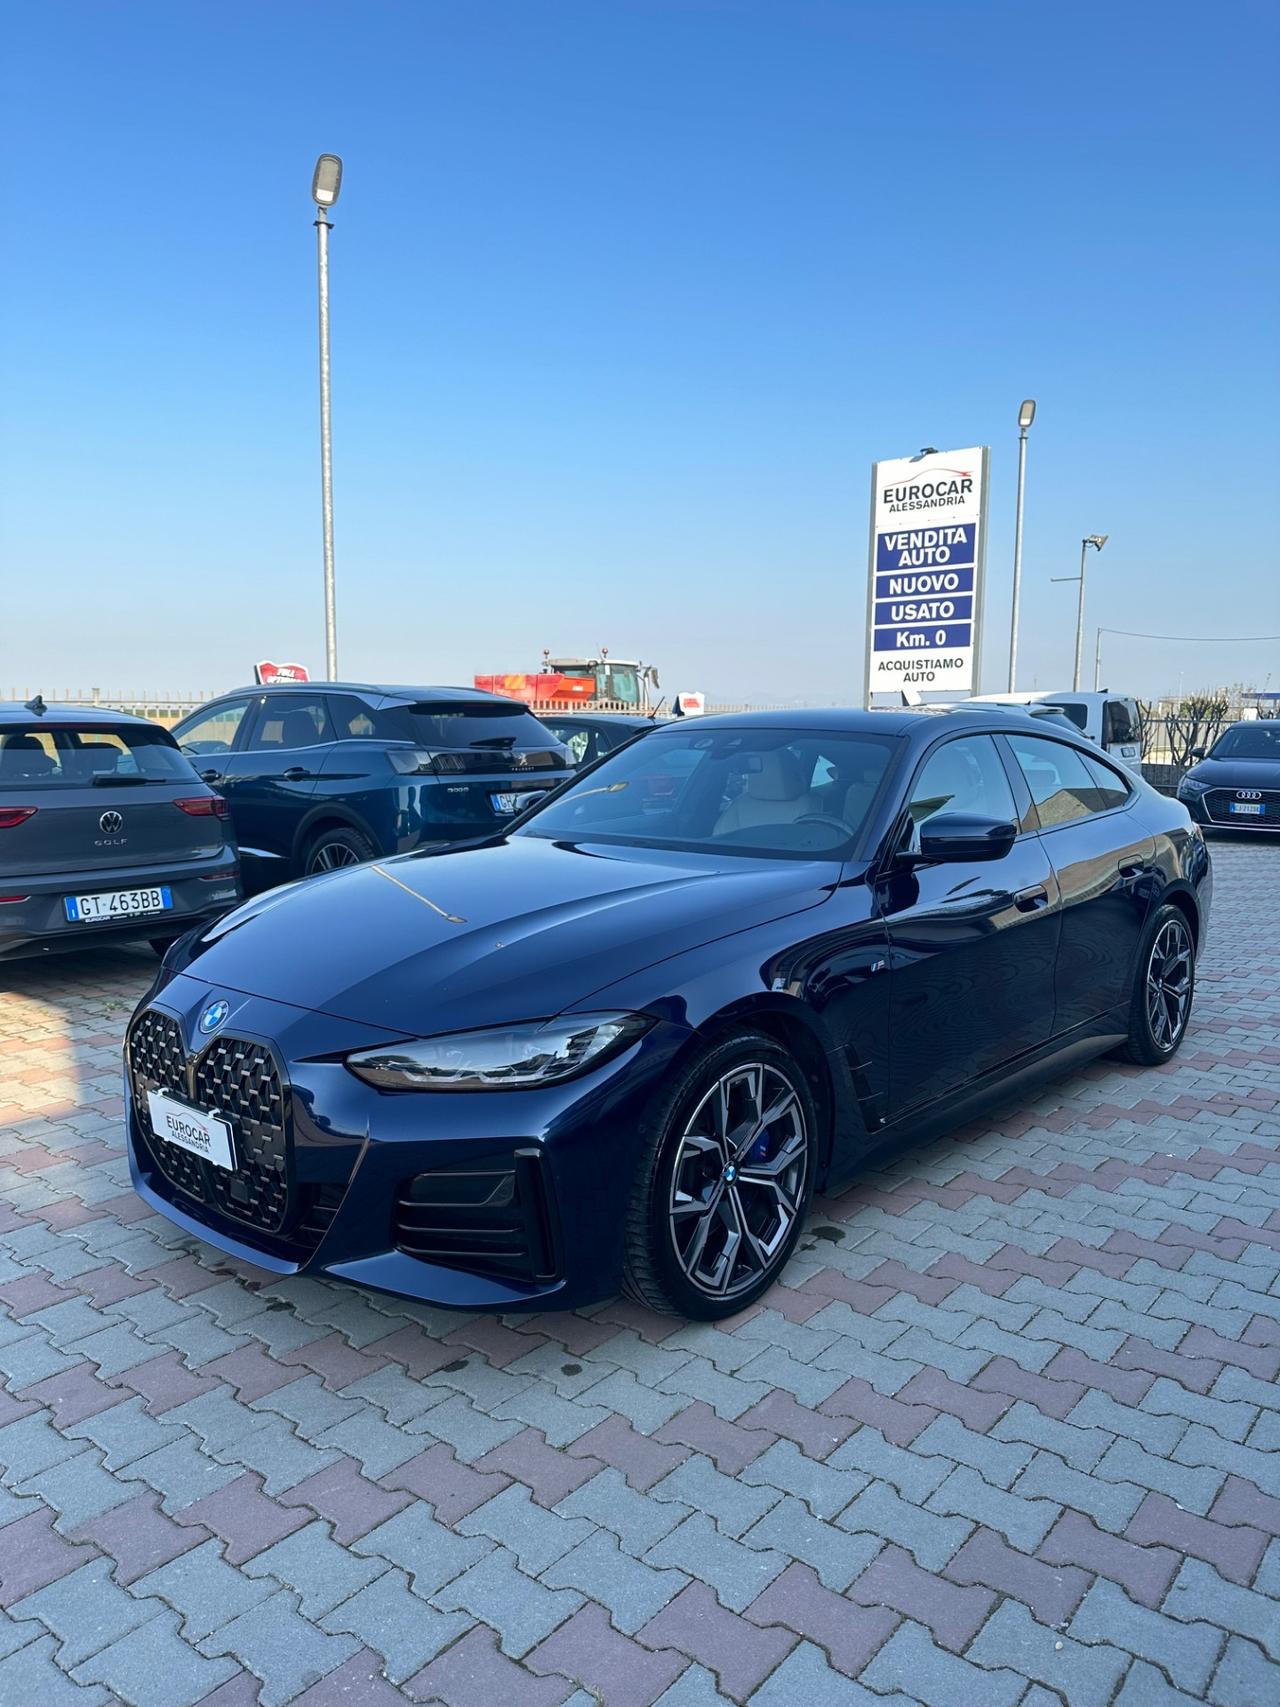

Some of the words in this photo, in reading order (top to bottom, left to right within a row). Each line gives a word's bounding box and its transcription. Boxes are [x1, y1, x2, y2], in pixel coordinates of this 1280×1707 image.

[883, 478, 973, 504] EUROCAR
[889, 495, 965, 513] ALESSANDRIA
[884, 527, 967, 551] VENDITA
[898, 546, 951, 567] AUTO
[889, 573, 959, 595] NUOVO
[891, 601, 955, 621] USATO
[896, 631, 930, 648] Km.
[935, 629, 947, 646] 0
[878, 657, 964, 671] ACQUISTIAMO
[903, 671, 936, 682] AUTO
[94, 838, 128, 846] GOLF
[166, 1114, 211, 1148] EUROCAR
[171, 1130, 210, 1154] ALESSANDRIA
